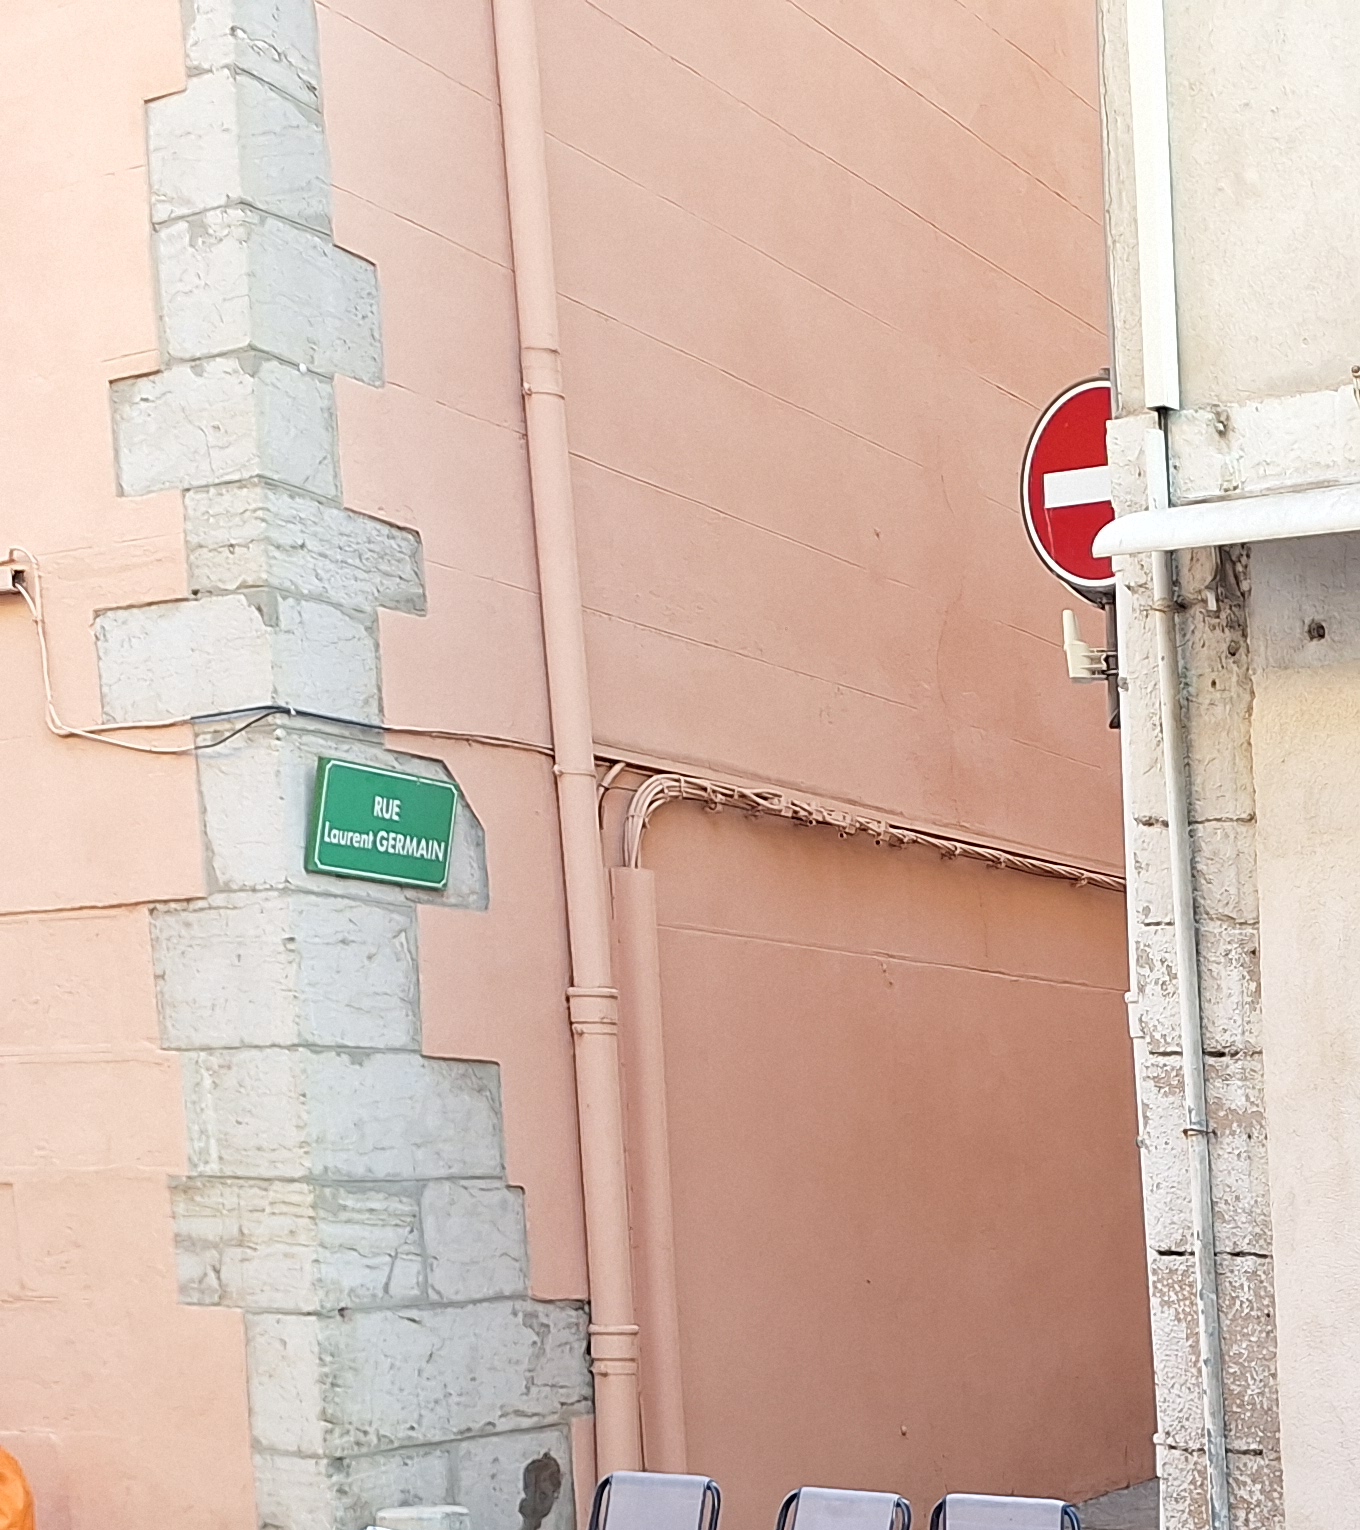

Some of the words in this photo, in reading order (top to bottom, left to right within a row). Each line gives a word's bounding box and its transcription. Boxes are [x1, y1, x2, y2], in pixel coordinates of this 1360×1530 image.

[374, 796, 401, 821] RUE
[324, 821, 373, 849] Laurent
[376, 830, 445, 862] GERMAIN
